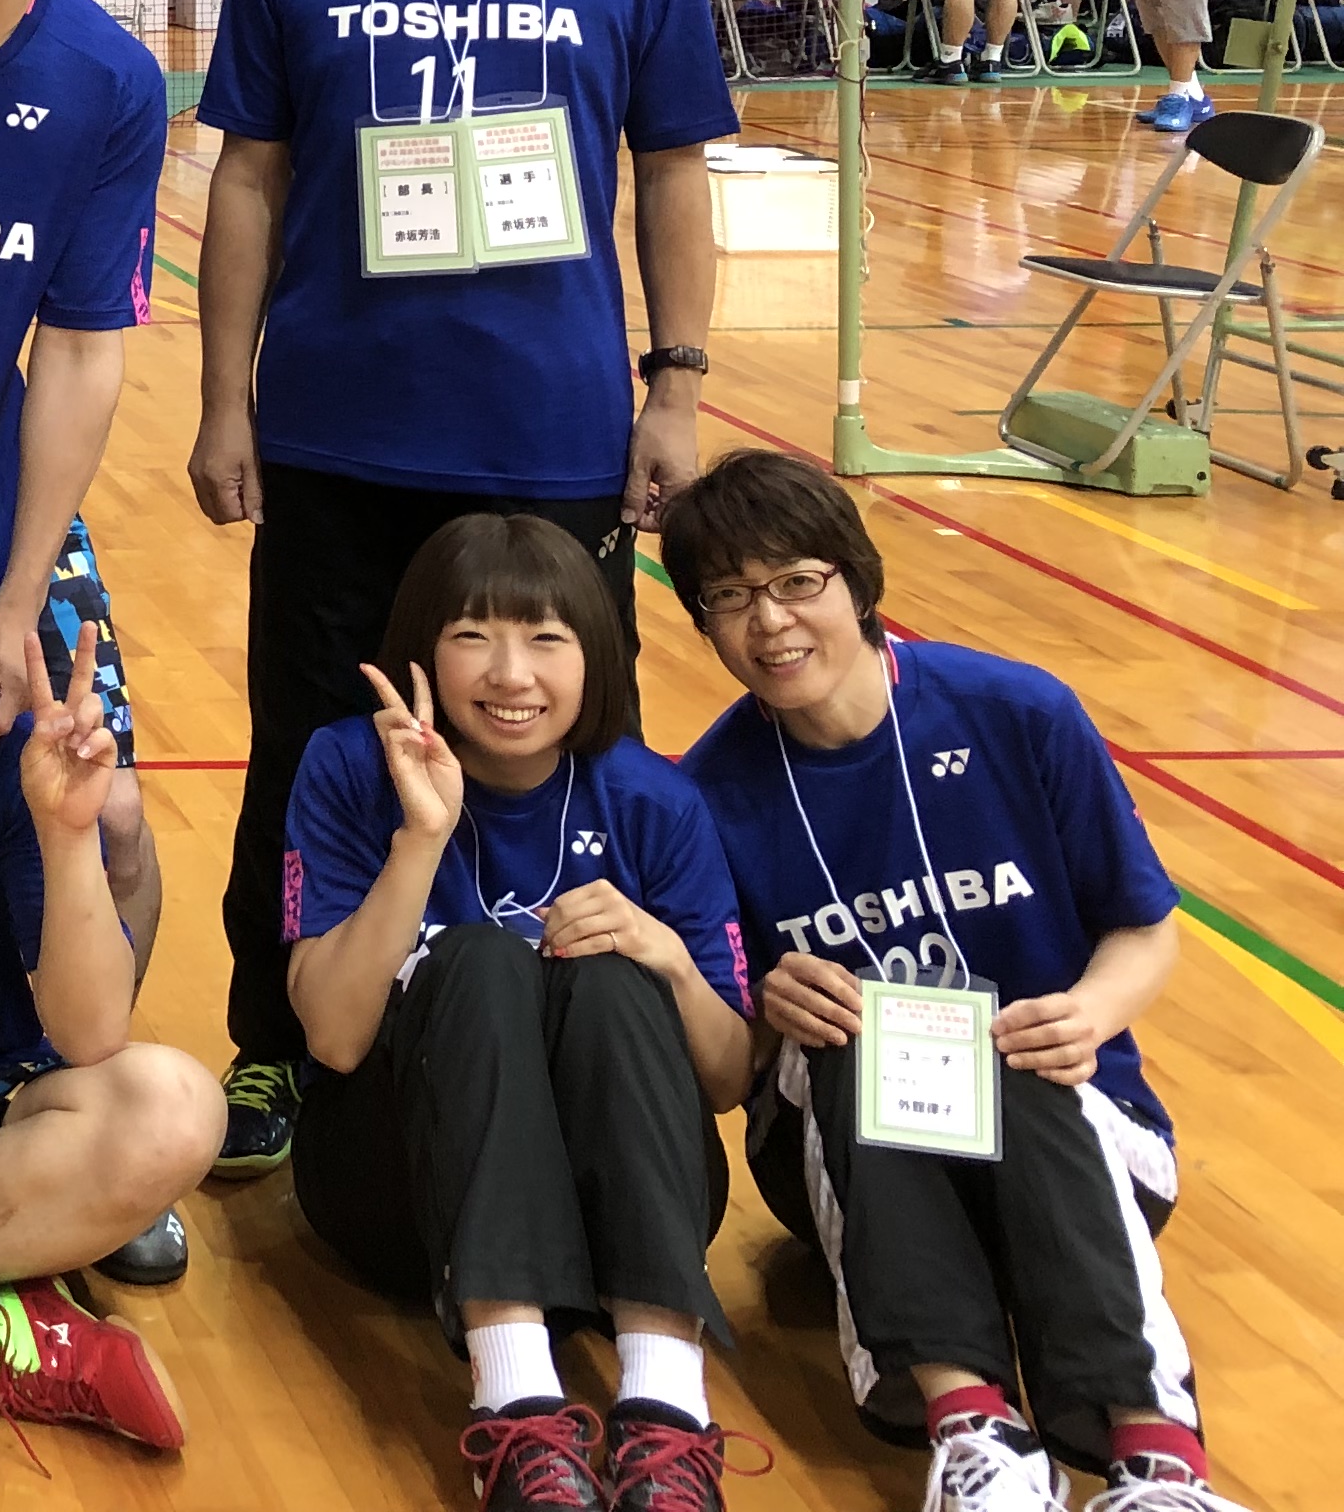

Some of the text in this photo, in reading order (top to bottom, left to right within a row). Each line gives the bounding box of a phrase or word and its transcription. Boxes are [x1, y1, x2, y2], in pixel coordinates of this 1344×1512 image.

[328, 1, 583, 45] TOSHIBA
[411, 55, 477, 125] 11
[776, 861, 1034, 953] TOSHIBA
